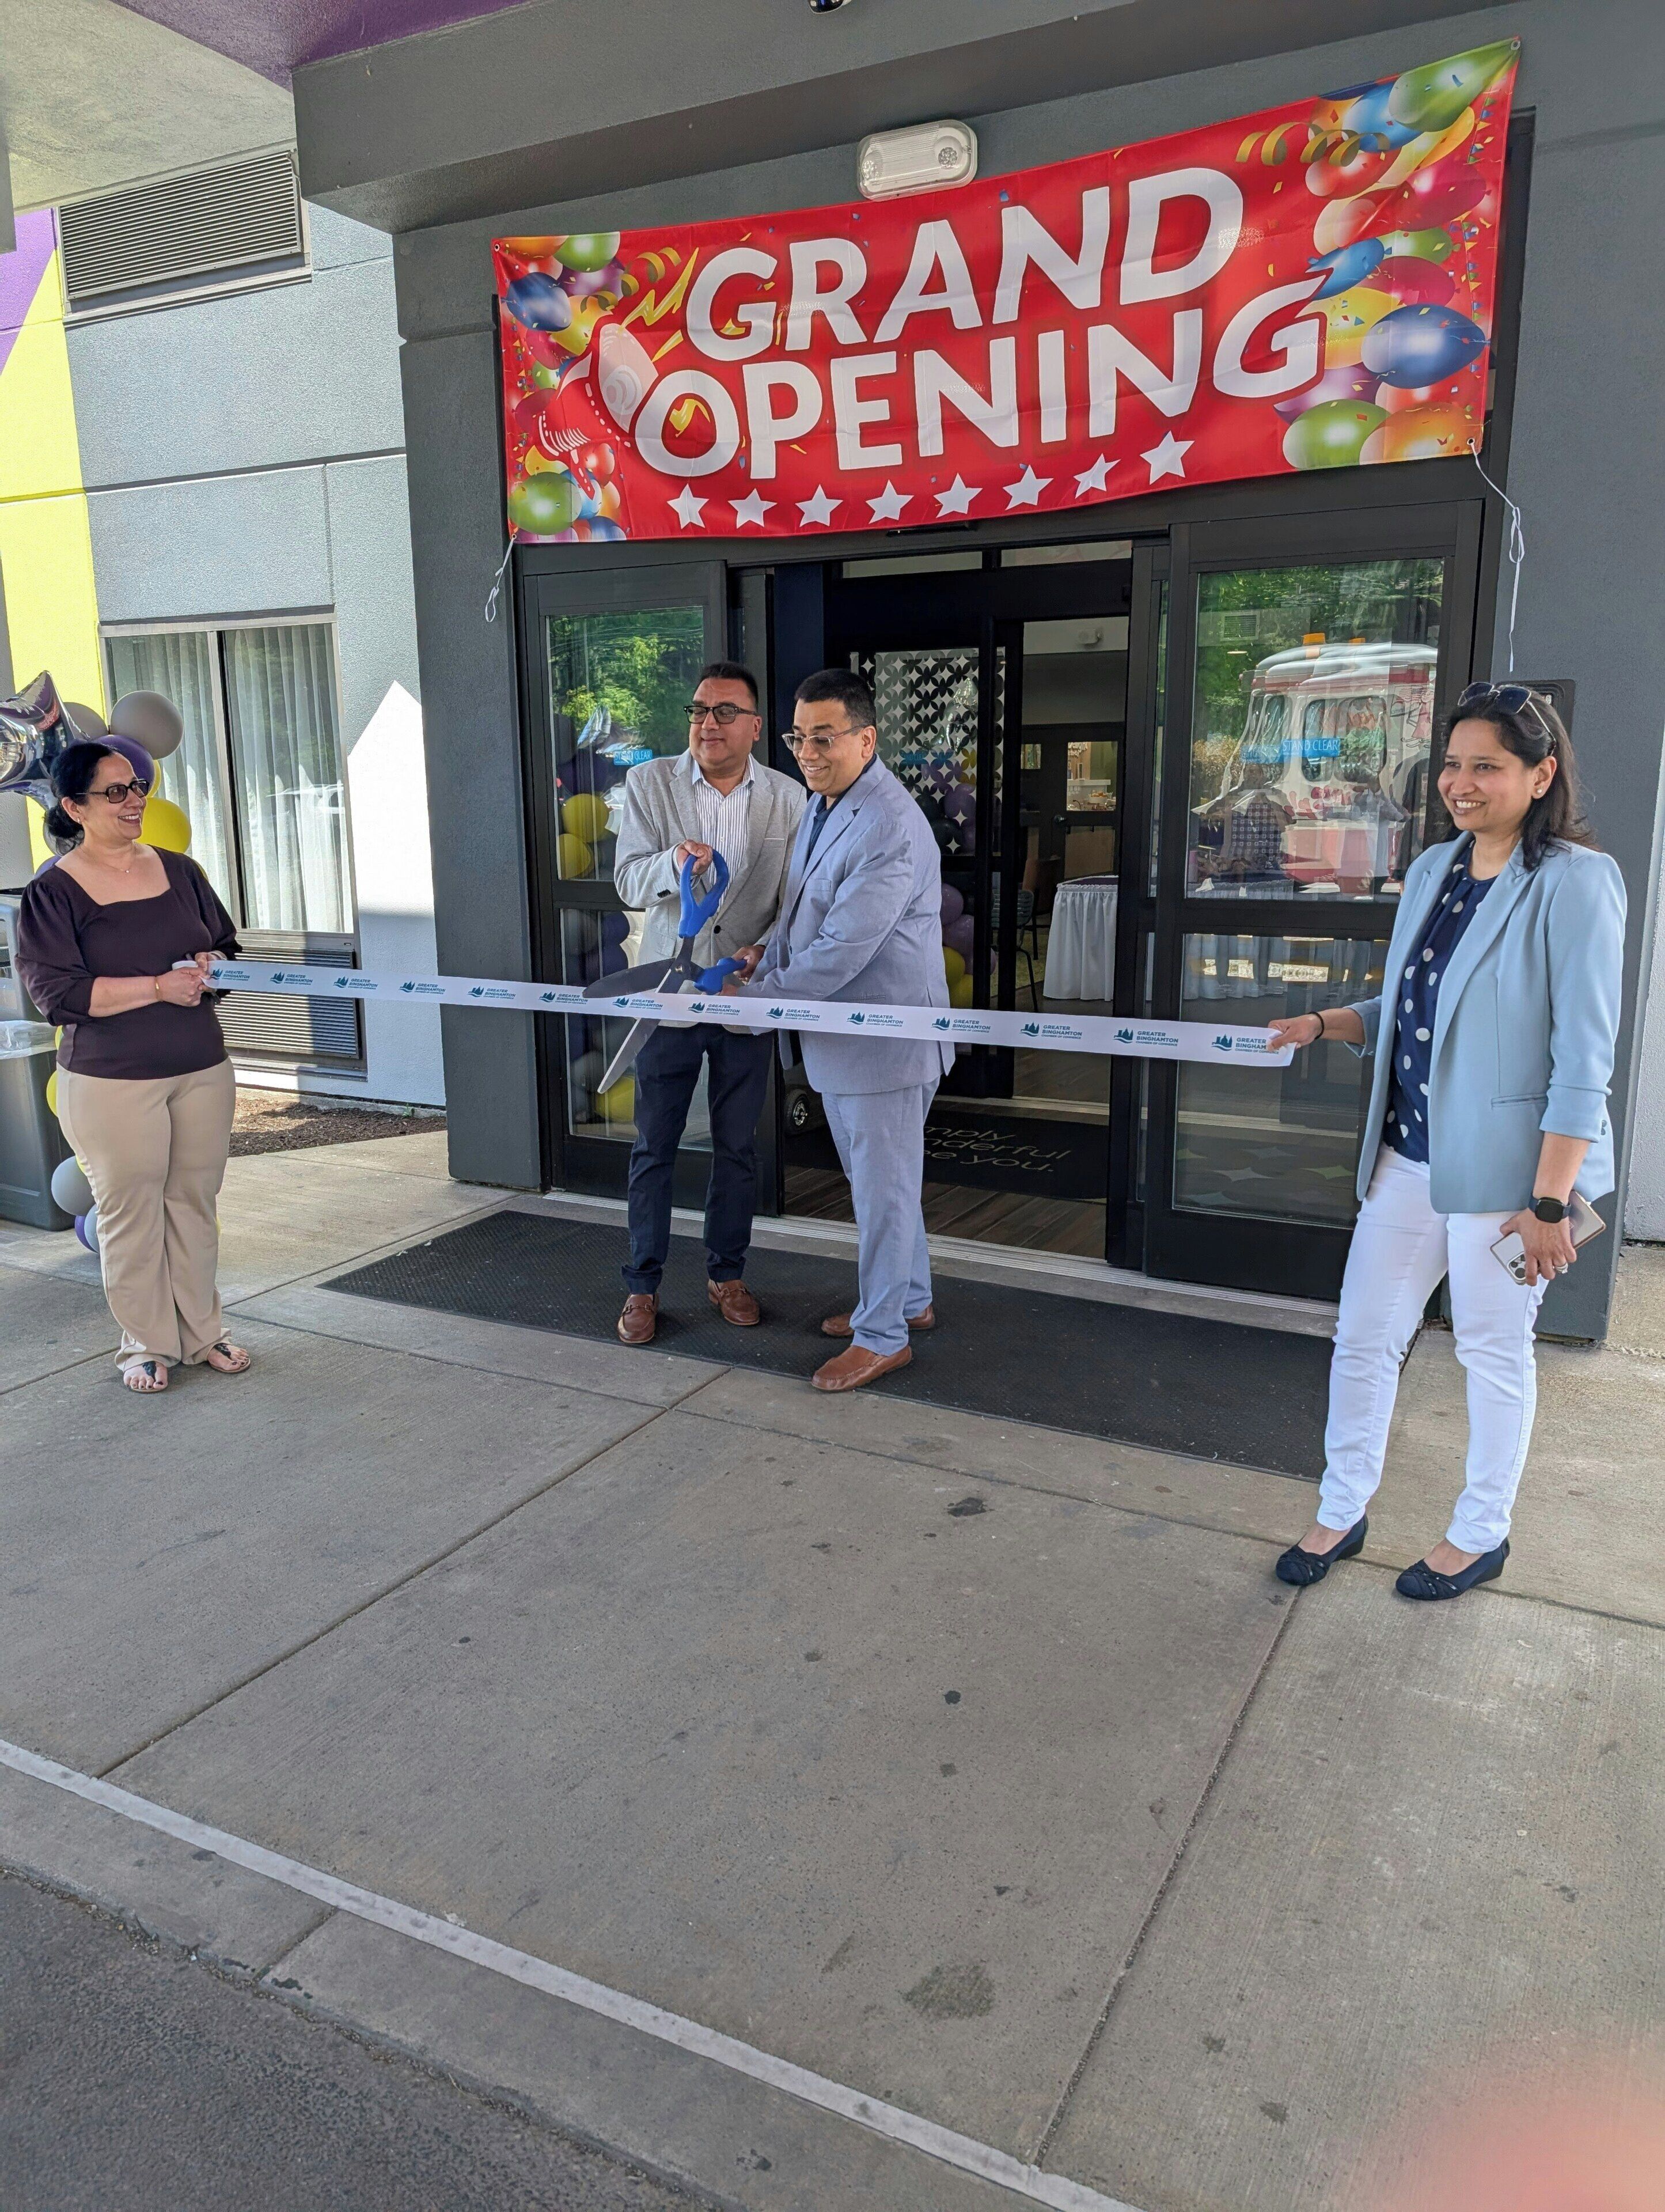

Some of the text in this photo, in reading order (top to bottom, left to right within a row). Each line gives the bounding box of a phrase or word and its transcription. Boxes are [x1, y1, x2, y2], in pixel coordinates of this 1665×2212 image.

[687, 168, 1243, 362] GRAND
[635, 275, 1326, 479] OPENING
[1283, 740, 1338, 751] STAND CLEAR
[634, 751, 651, 760] CLEAR
[924, 1126, 1017, 1141] mply
[924, 1138, 1071, 1159] nderful
[960, 1155, 1053, 1172] you.
